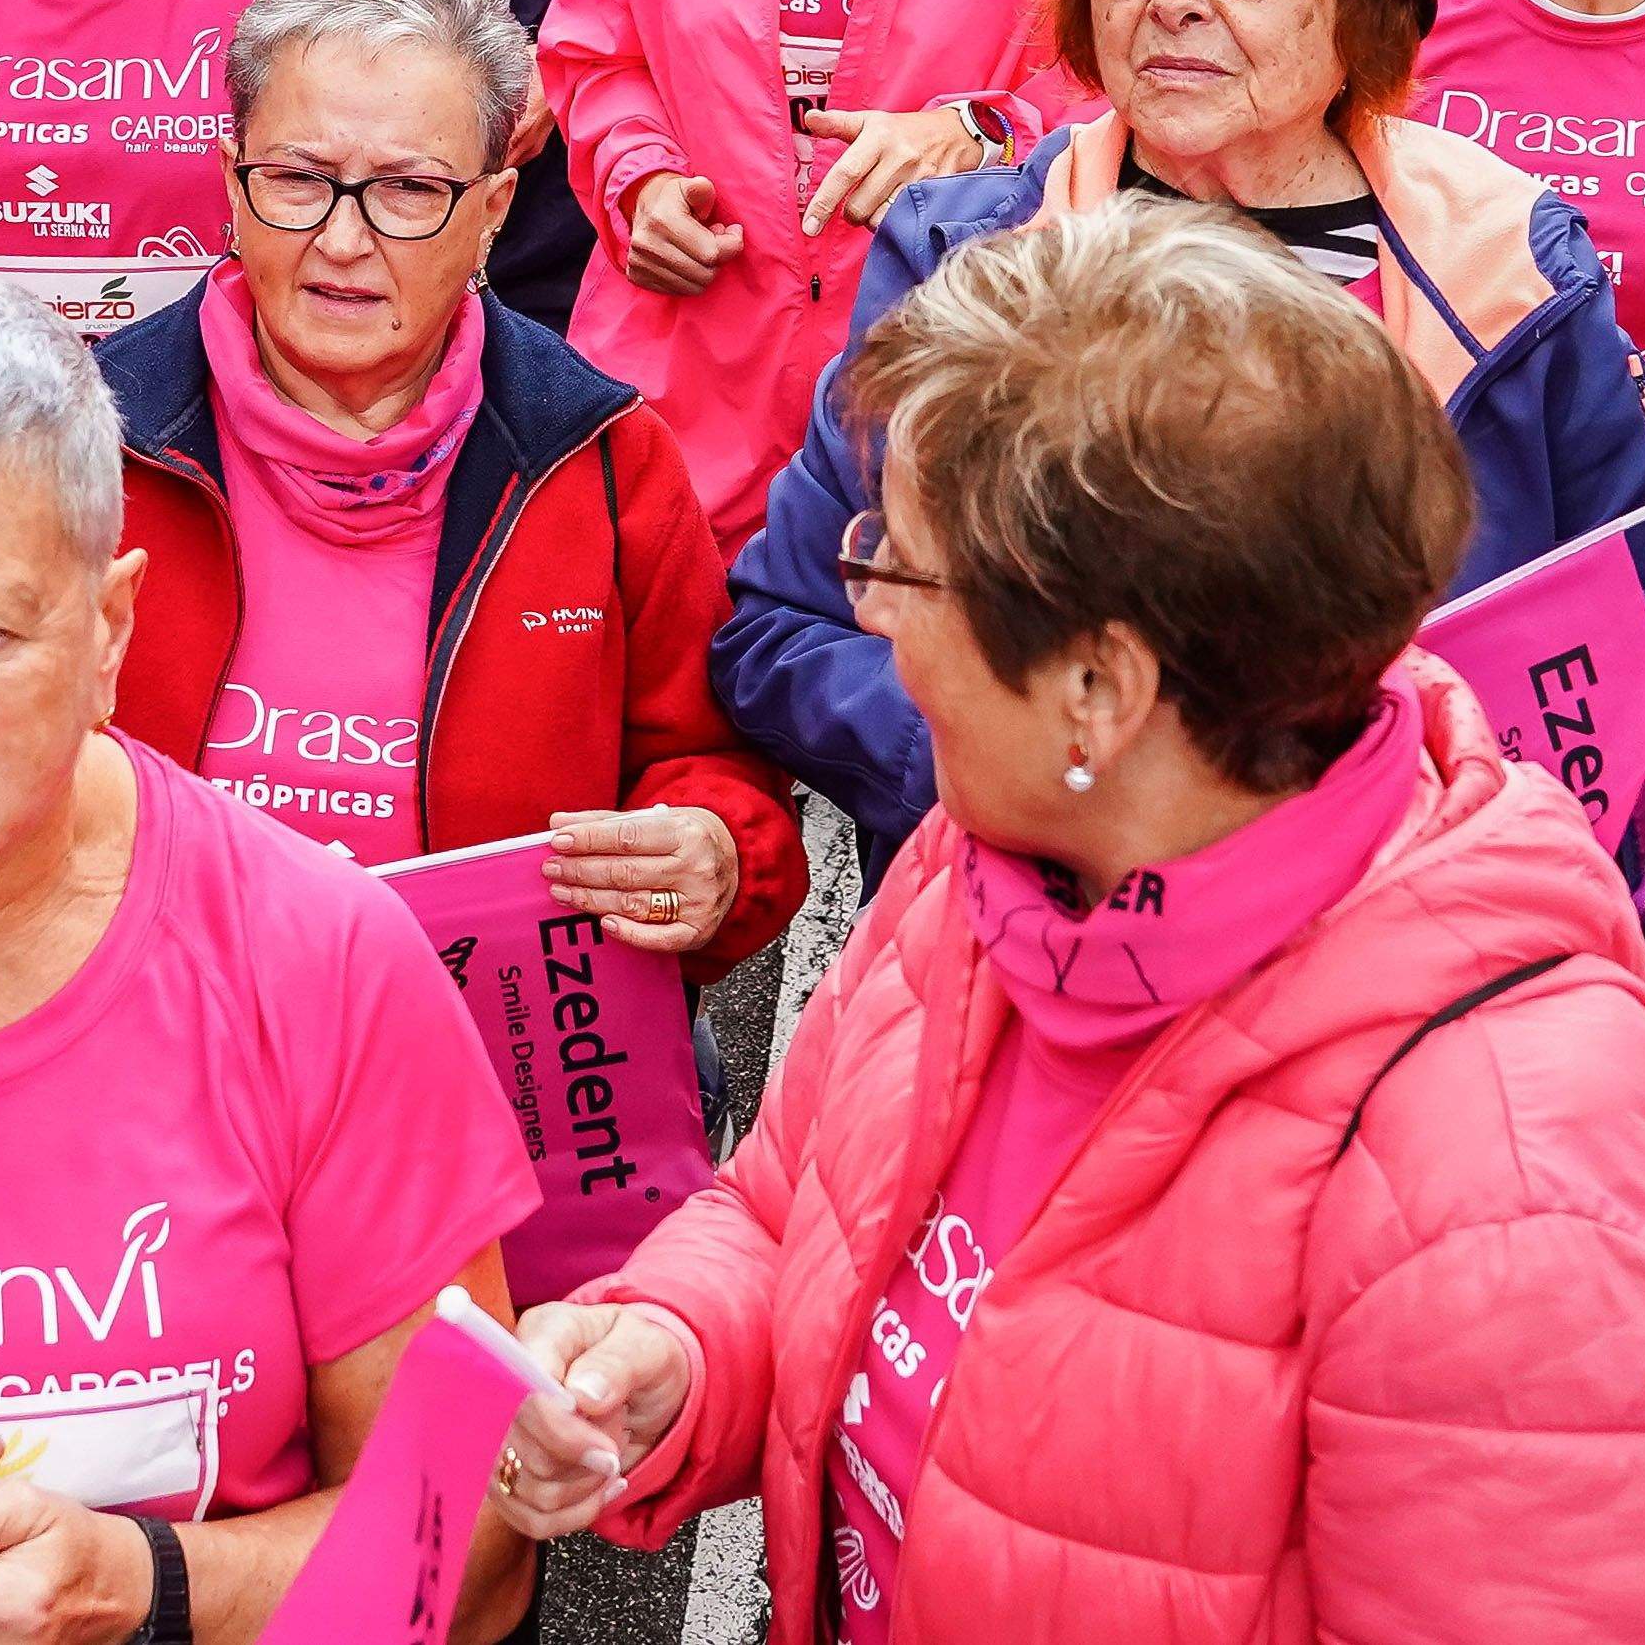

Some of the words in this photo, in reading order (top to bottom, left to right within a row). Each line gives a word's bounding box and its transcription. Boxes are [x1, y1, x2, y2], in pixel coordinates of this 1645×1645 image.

[125, 141, 151, 154] hair
[163, 141, 208, 155] beauty
[34, 223, 49, 238] LA
[50, 223, 87, 239] SERNA
[88, 224, 111, 239] 4X4
[497, 963, 529, 1037] Smile
[539, 913, 637, 1197] Ezedent
[509, 1041, 547, 1164] Designers
